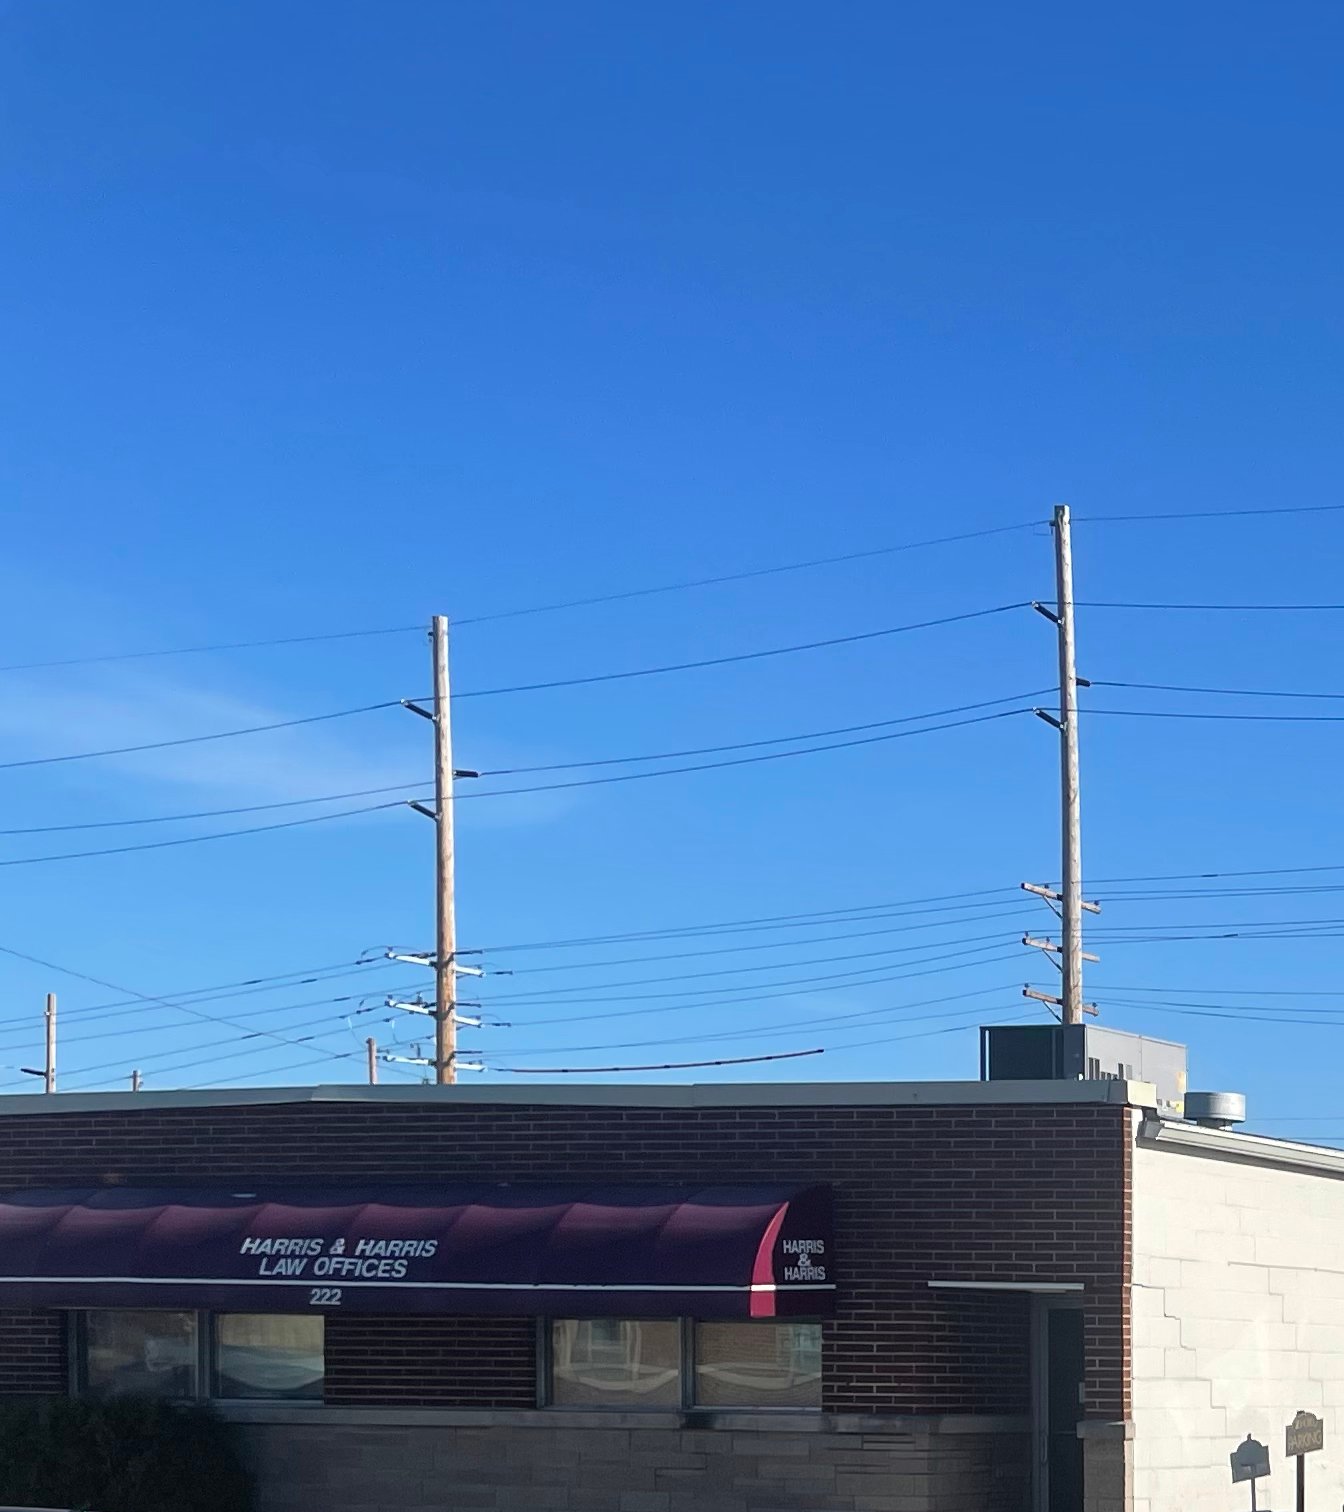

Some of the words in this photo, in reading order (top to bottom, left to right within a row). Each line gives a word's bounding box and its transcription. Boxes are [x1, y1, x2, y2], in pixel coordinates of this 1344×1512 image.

[240, 1238, 323, 1255] HARRIS
[329, 1238, 345, 1254] &
[355, 1239, 438, 1256] HARRIS
[783, 1240, 824, 1254] HARRIS
[259, 1257, 308, 1275] LAW
[314, 1257, 408, 1277] OFFICES
[798, 1253, 811, 1266] &
[784, 1266, 826, 1280] HARRIS
[310, 1288, 342, 1305] 222
